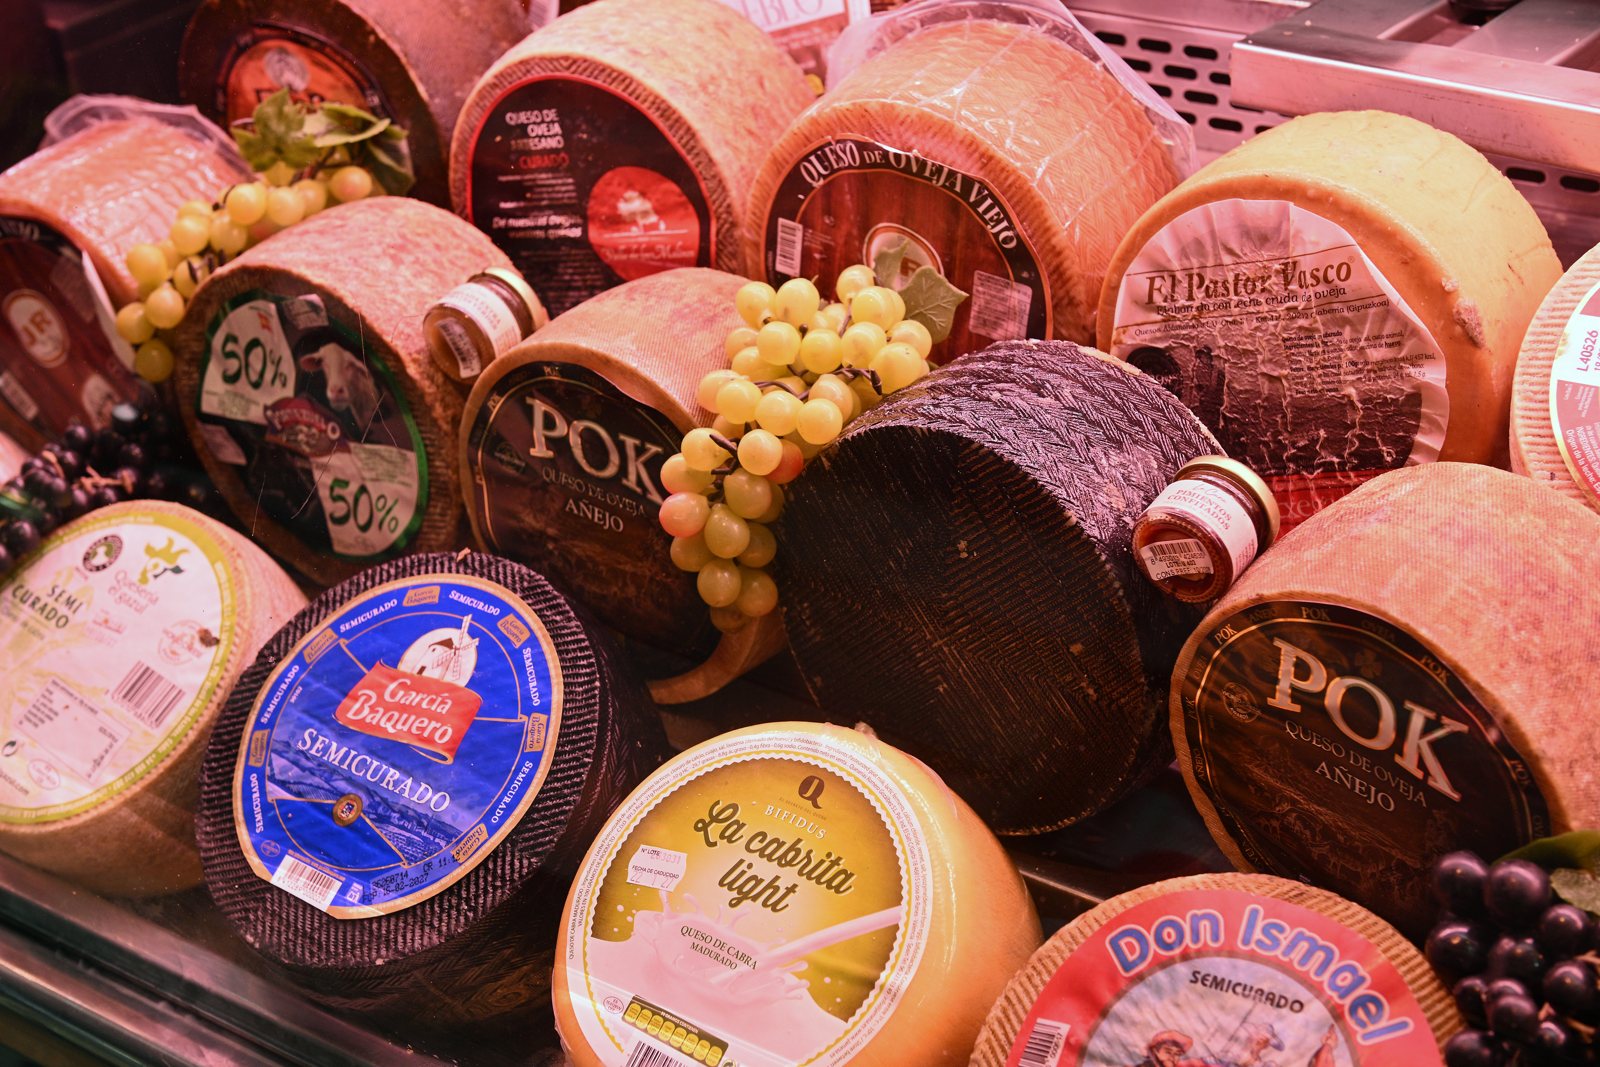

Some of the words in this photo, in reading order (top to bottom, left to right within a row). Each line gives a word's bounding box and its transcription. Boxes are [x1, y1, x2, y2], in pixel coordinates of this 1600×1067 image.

[505, 111, 543, 125] QUESO
[543, 109, 559, 121] DE
[527, 123, 563, 137] OVEJA
[519, 153, 569, 168] CURADO
[800, 141, 860, 188] QUESO
[863, 150, 885, 164] DE
[888, 151, 963, 193] OVEJA
[968, 180, 1018, 250] VIEJO
[1145, 271, 1176, 304] El
[1184, 271, 1272, 302] Pastor
[1279, 260, 1352, 293] Vasco
[1213, 301, 1231, 311] con
[1265, 291, 1299, 304] cruda
[1301, 291, 1312, 303] de
[1315, 286, 1348, 300] oveja
[1346, 298, 1391, 314] (Gipuzkoa)
[20, 310, 50, 346] JR
[220, 333, 288, 390] 50%
[1576, 329, 1599, 373] L40526
[526, 397, 664, 504] POK
[1566, 429, 1578, 451] Origen
[329, 477, 399, 533] 50%
[542, 466, 585, 493] QUESO
[588, 484, 606, 501] DE
[606, 492, 647, 517] OVEJA
[1175, 488, 1233, 522] PIMIENTOS
[565, 498, 624, 532] AÑEJO
[1167, 494, 1231, 530] CONFITADOS
[12, 584, 69, 629] CURADO
[46, 584, 83, 615] SEMI
[339, 598, 398, 633] SEMICURADO
[449, 590, 501, 616] SEMICURADO
[1301, 606, 1331, 621] POK
[1214, 624, 1238, 645] POK
[522, 647, 541, 707] SEMICURADO
[1419, 655, 1452, 683] POK
[260, 665, 300, 725] SEMICURADO
[383, 679, 453, 715] García
[346, 689, 453, 744] Baquero
[528, 716, 541, 749] Baquero
[1267, 637, 1469, 802] POK
[297, 727, 451, 812] SEMICURADO
[1285, 720, 1346, 759] QUESO
[1350, 752, 1372, 773] DE
[1373, 762, 1427, 807] OVEJA
[250, 773, 264, 834] SEMICURADO
[491, 761, 534, 824] SEMICURADO
[1315, 760, 1395, 812] AÑEJO
[765, 804, 827, 839] BIFIDUS
[647, 849, 661, 857] LOTE
[693, 799, 746, 848] La
[744, 826, 858, 895] cabrita
[576, 905, 586, 927] VALORES
[586, 867, 598, 889] GRAMOS
[597, 835, 616, 862] PRODUCTO
[631, 864, 647, 872] FECHA
[653, 869, 680, 879] CADUCIDAD
[718, 858, 799, 913] light
[571, 887, 584, 918] MADURADO
[569, 916, 577, 935] CABRA
[680, 924, 712, 949] QUESO
[711, 938, 728, 955] DE
[726, 945, 758, 971] CABRA
[689, 943, 738, 972] MADURADO
[1104, 907, 1225, 979] Don
[1237, 903, 1414, 1046] Ismael
[1188, 969, 1305, 1014] SEMICURADO
